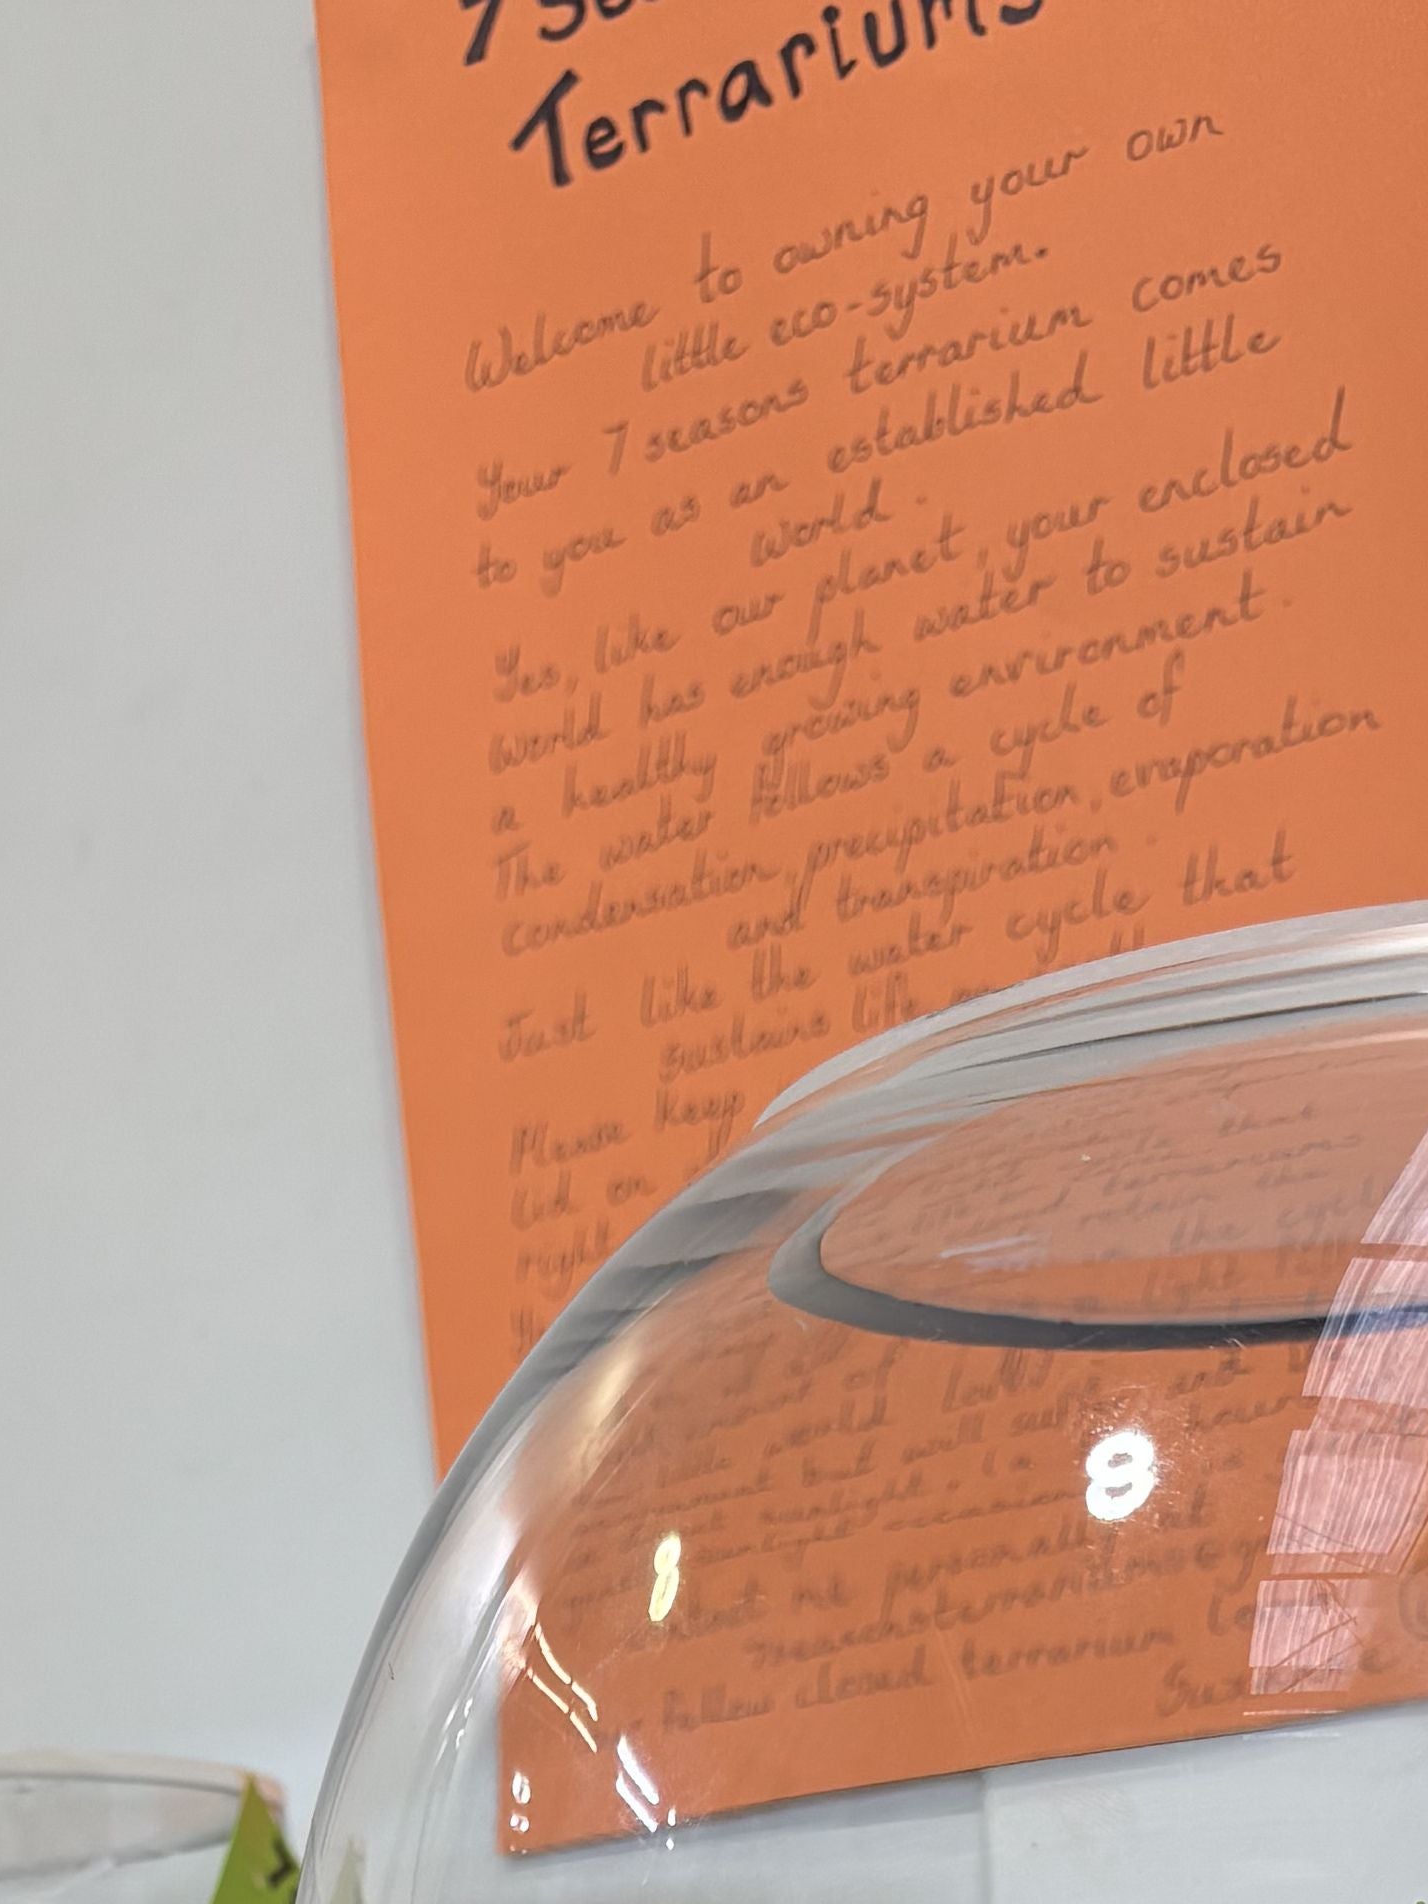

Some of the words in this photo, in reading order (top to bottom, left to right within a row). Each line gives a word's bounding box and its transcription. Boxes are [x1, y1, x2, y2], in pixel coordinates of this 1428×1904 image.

[465, 311, 661, 392] Welcome
[694, 231, 743, 303] to
[774, 191, 928, 274] owning
[966, 146, 1089, 246] your
[1126, 113, 1225, 161] own
[641, 321, 749, 392] little
[771, 231, 1049, 346] eco-system.
[473, 540, 518, 588] to
[540, 524, 627, 598] you
[651, 494, 702, 537] as
[729, 470, 790, 509] an
[827, 349, 1103, 474] established
[1142, 313, 1282, 389] little
[476, 459, 572, 521] Your
[602, 418, 629, 476] 7
[644, 376, 810, 462] seasons
[845, 304, 1094, 394] terrarium
[1131, 242, 1284, 312] comes
[593, 612, 681, 673] like
[712, 591, 785, 635] our
[1002, 494, 1110, 582] your
[1138, 385, 1353, 514] enclosed
[639, 672, 705, 729] has
[729, 606, 882, 710] enough
[913, 568, 1057, 642] water
[1087, 536, 1132, 596] to
[1155, 484, 1353, 580] sustain
[491, 804, 523, 835] a
[562, 730, 718, 817] healthy
[763, 680, 920, 780] growing
[493, 840, 565, 899] The
[599, 794, 714, 870] water
[748, 752, 891, 826] follows
[922, 745, 959, 773] a
[990, 682, 1110, 779] cycle
[1135, 648, 1187, 727] of
[1109, 695, 1382, 815] evaporation
[498, 990, 596, 1062] Just
[641, 963, 720, 1028] like
[751, 944, 820, 1000] the
[848, 910, 973, 977] water
[1005, 867, 1155, 965] cycle
[1182, 826, 1298, 905] that
[727, 895, 808, 951] and
[851, 969, 919, 1034] life
